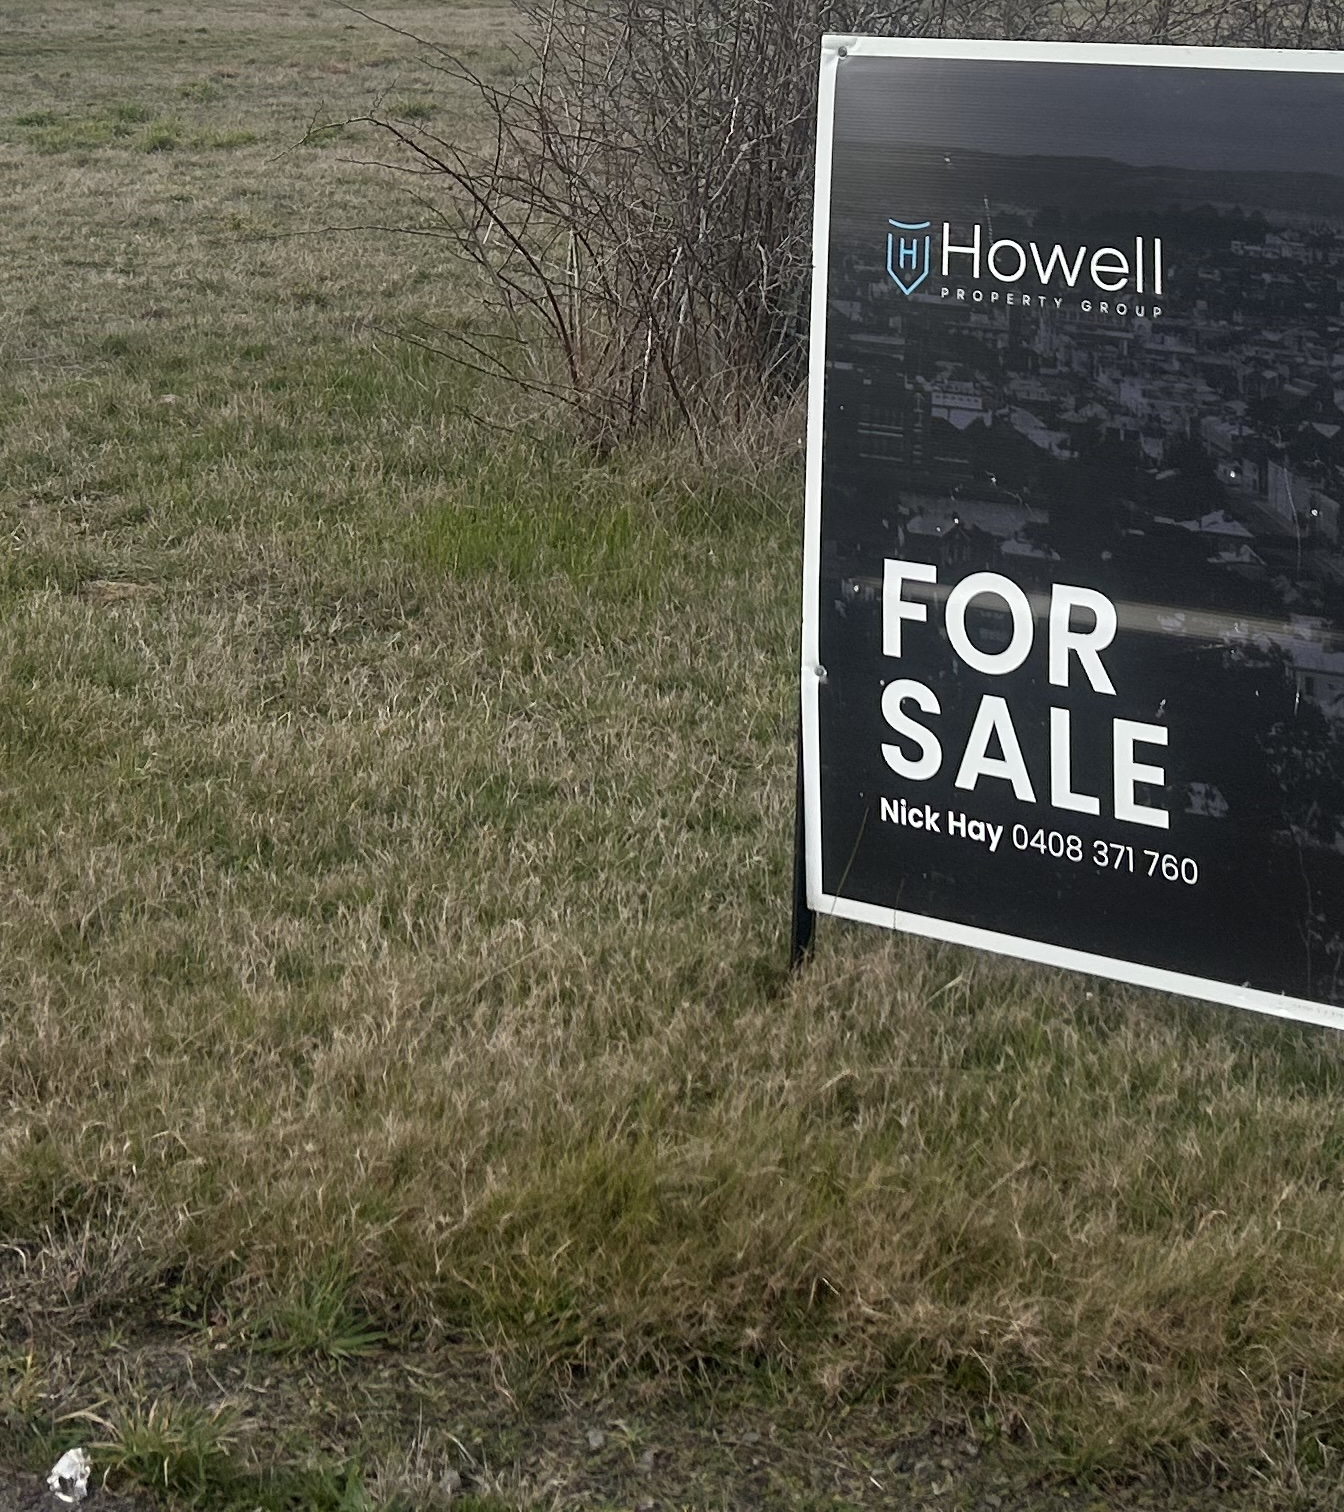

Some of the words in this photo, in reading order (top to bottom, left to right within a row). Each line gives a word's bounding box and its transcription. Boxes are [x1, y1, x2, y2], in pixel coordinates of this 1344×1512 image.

[899, 237, 918, 271] H
[941, 221, 1163, 295] Howell
[940, 287, 1064, 309] PROPERTY
[1081, 299, 1163, 318] GROUP
[882, 558, 1117, 696] FOR
[880, 678, 1170, 829] SALE
[880, 796, 941, 834] Nick
[947, 810, 1004, 853] Hay
[1011, 823, 1083, 863] 0408
[1092, 840, 1135, 874] 371
[1142, 849, 1199, 886] 760
